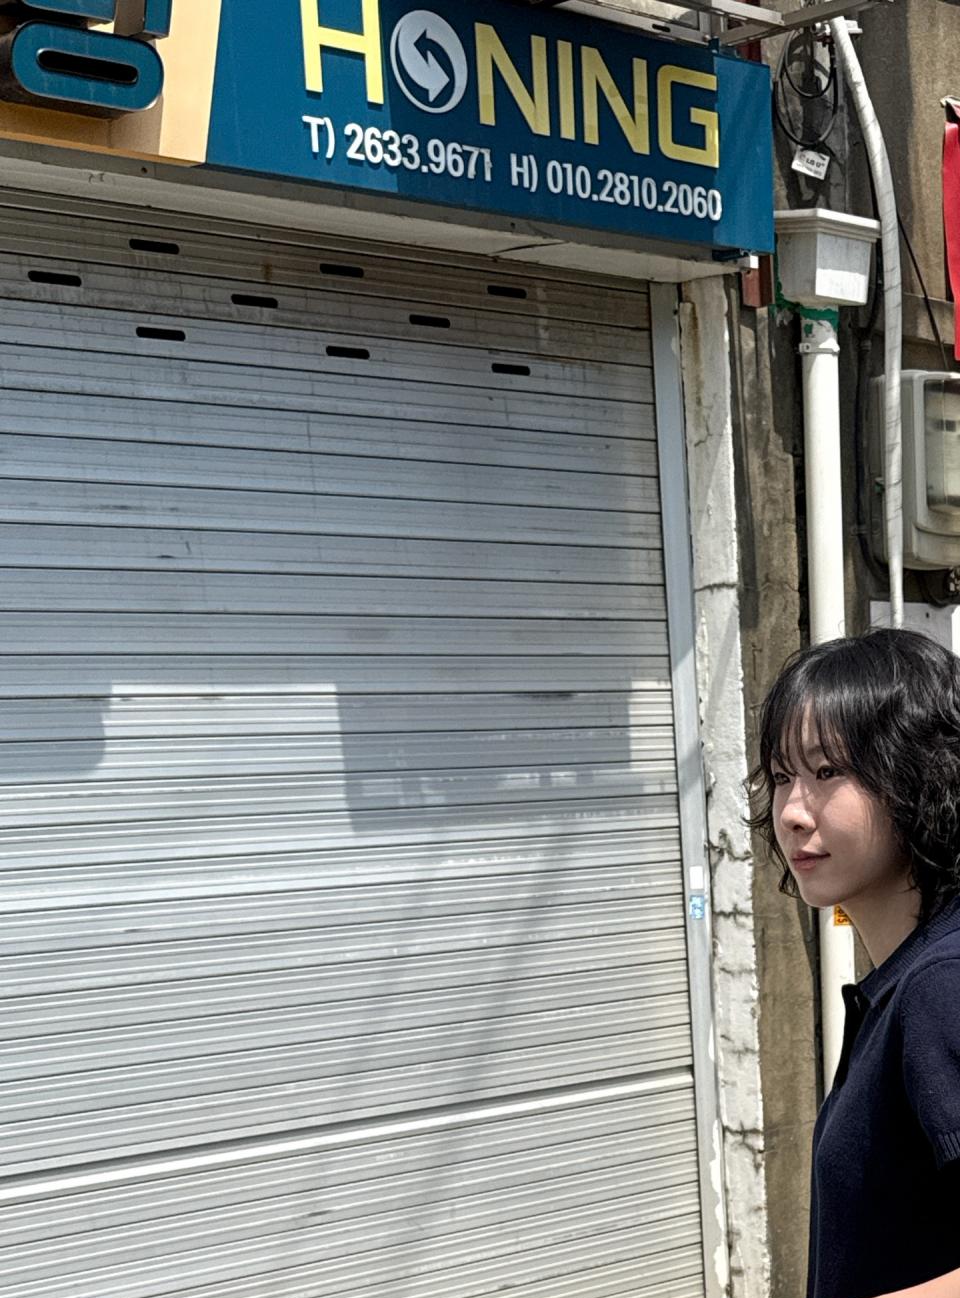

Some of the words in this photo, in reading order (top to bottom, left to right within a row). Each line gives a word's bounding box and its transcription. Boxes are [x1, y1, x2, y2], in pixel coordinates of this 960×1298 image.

[302, 115, 335, 159] T)
[344, 123, 493, 182] 2633.9671
[510, 153, 538, 192] H)
[546, 160, 722, 221] 010.2810.2060
